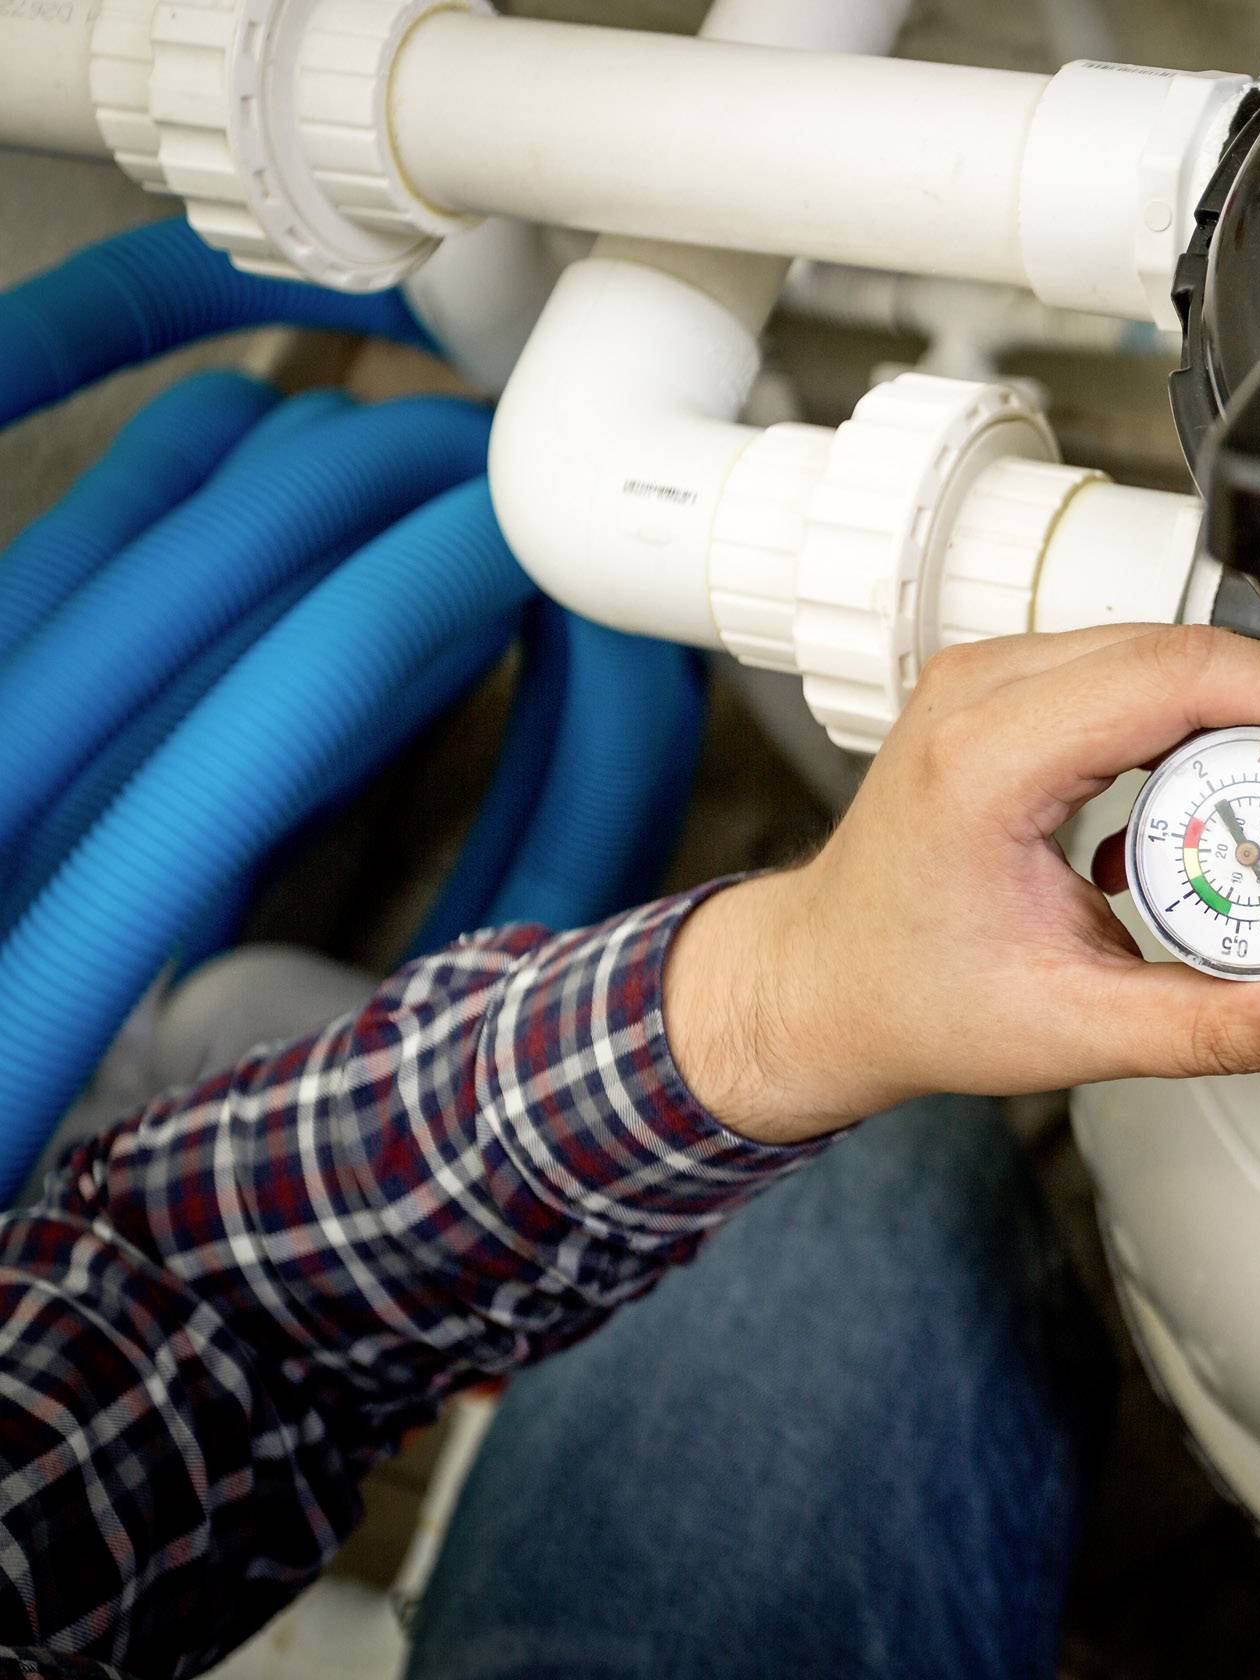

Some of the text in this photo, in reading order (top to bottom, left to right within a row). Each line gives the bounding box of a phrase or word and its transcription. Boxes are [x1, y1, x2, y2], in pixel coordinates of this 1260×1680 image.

[1192, 760, 1208, 778] 2
[1148, 819, 1169, 843] 1,5
[1215, 843, 1228, 860] 20
[1231, 871, 1243, 884] 10
[1165, 900, 1180, 912] 1
[1222, 936, 1248, 958] 0,5
